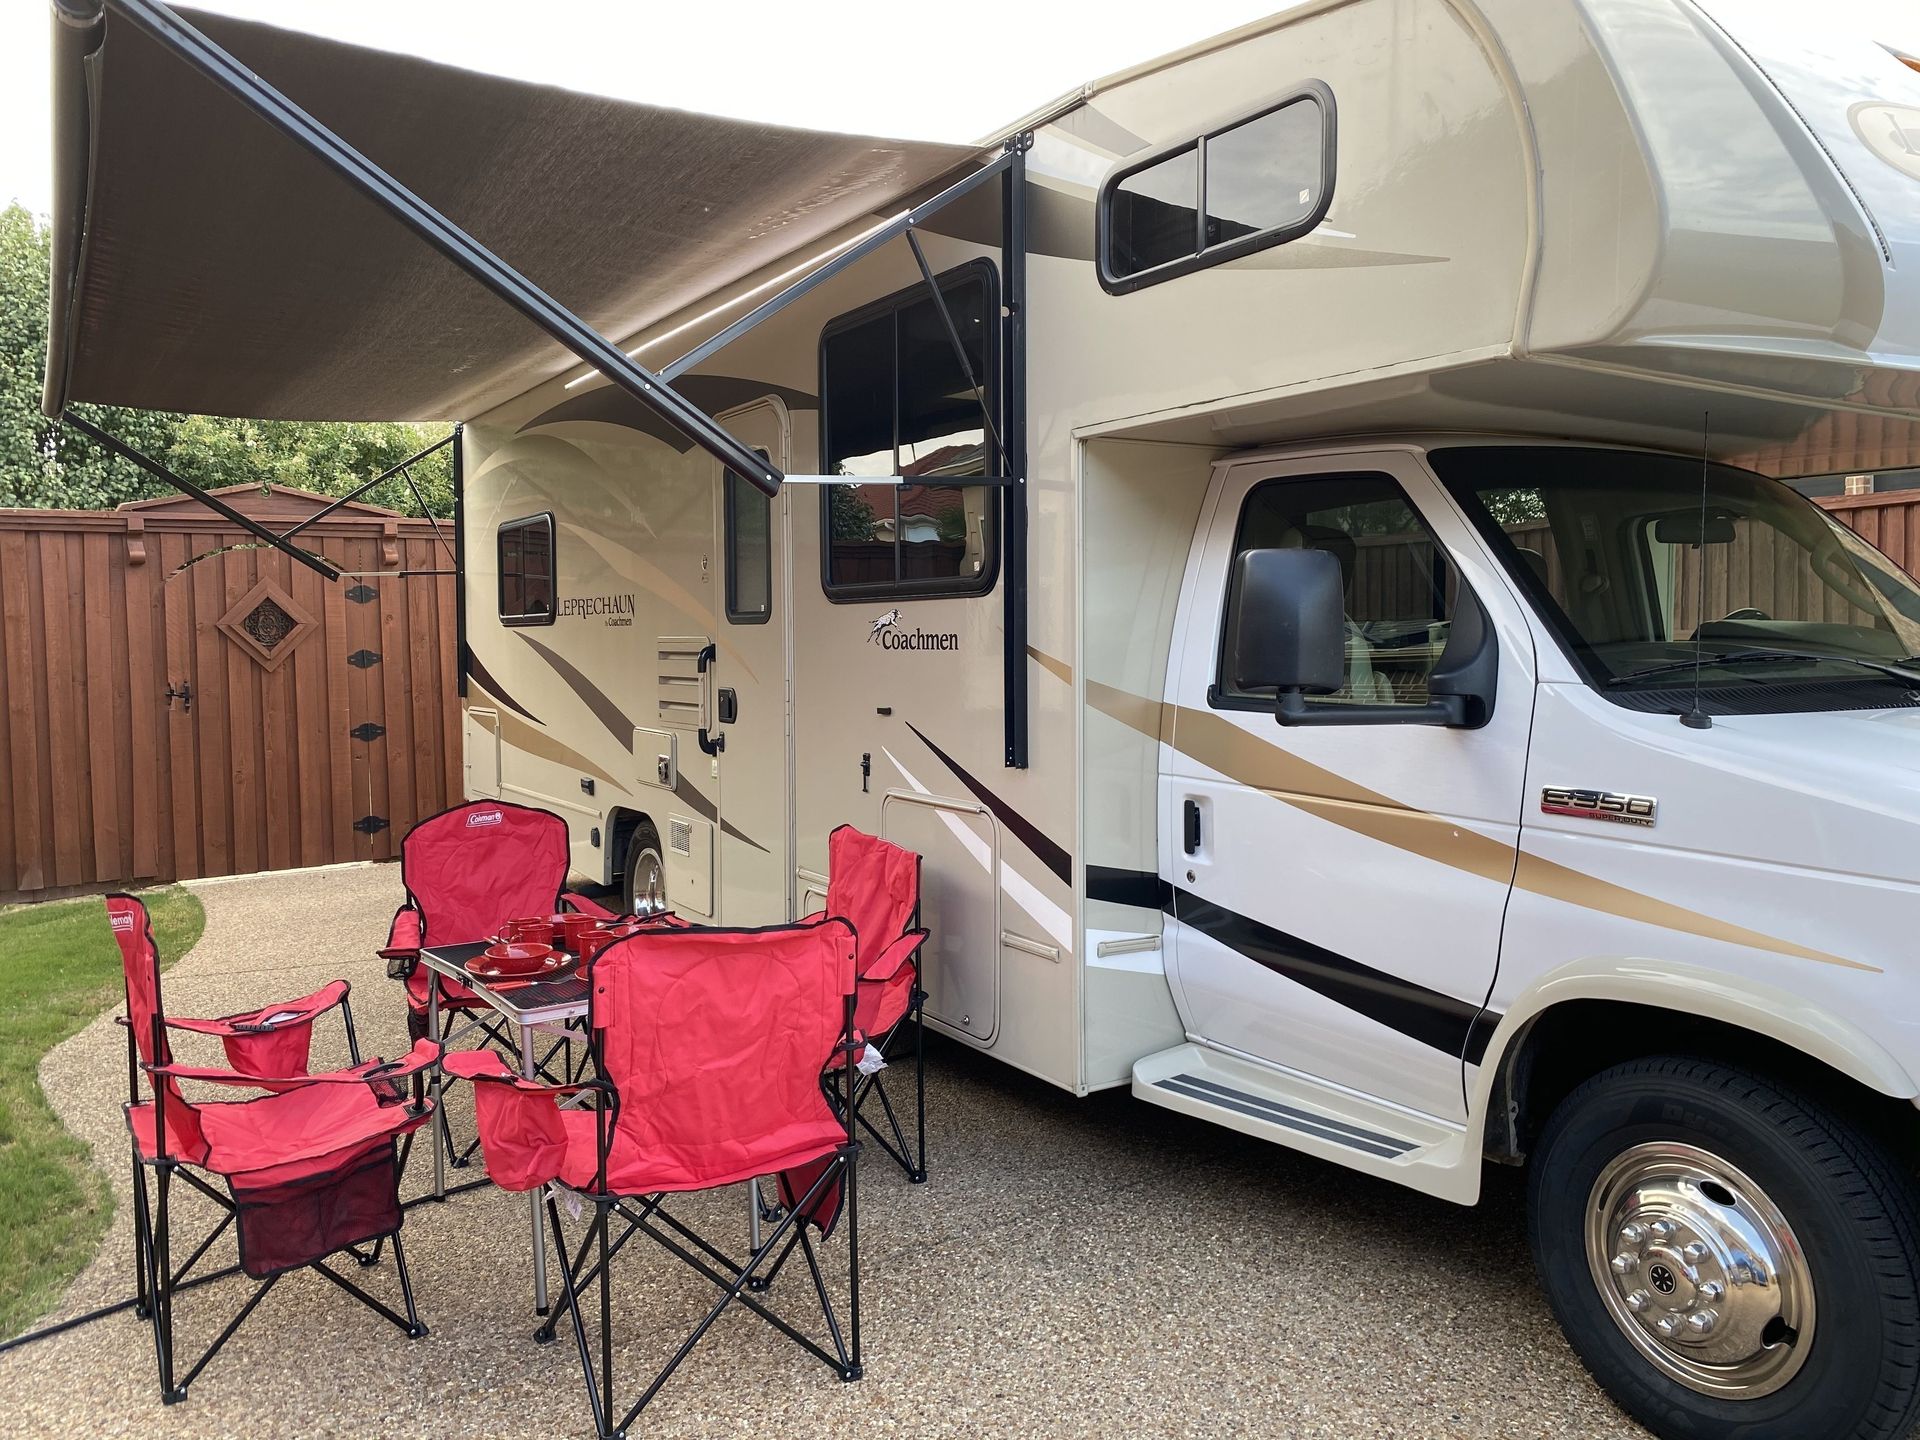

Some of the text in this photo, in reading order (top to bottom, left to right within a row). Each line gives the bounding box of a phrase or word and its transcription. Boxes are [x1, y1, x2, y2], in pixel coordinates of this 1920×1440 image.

[557, 594, 635, 619] LEPRECHAUN
[608, 616, 632, 627] Coachmen
[882, 628, 959, 650] Coachmen
